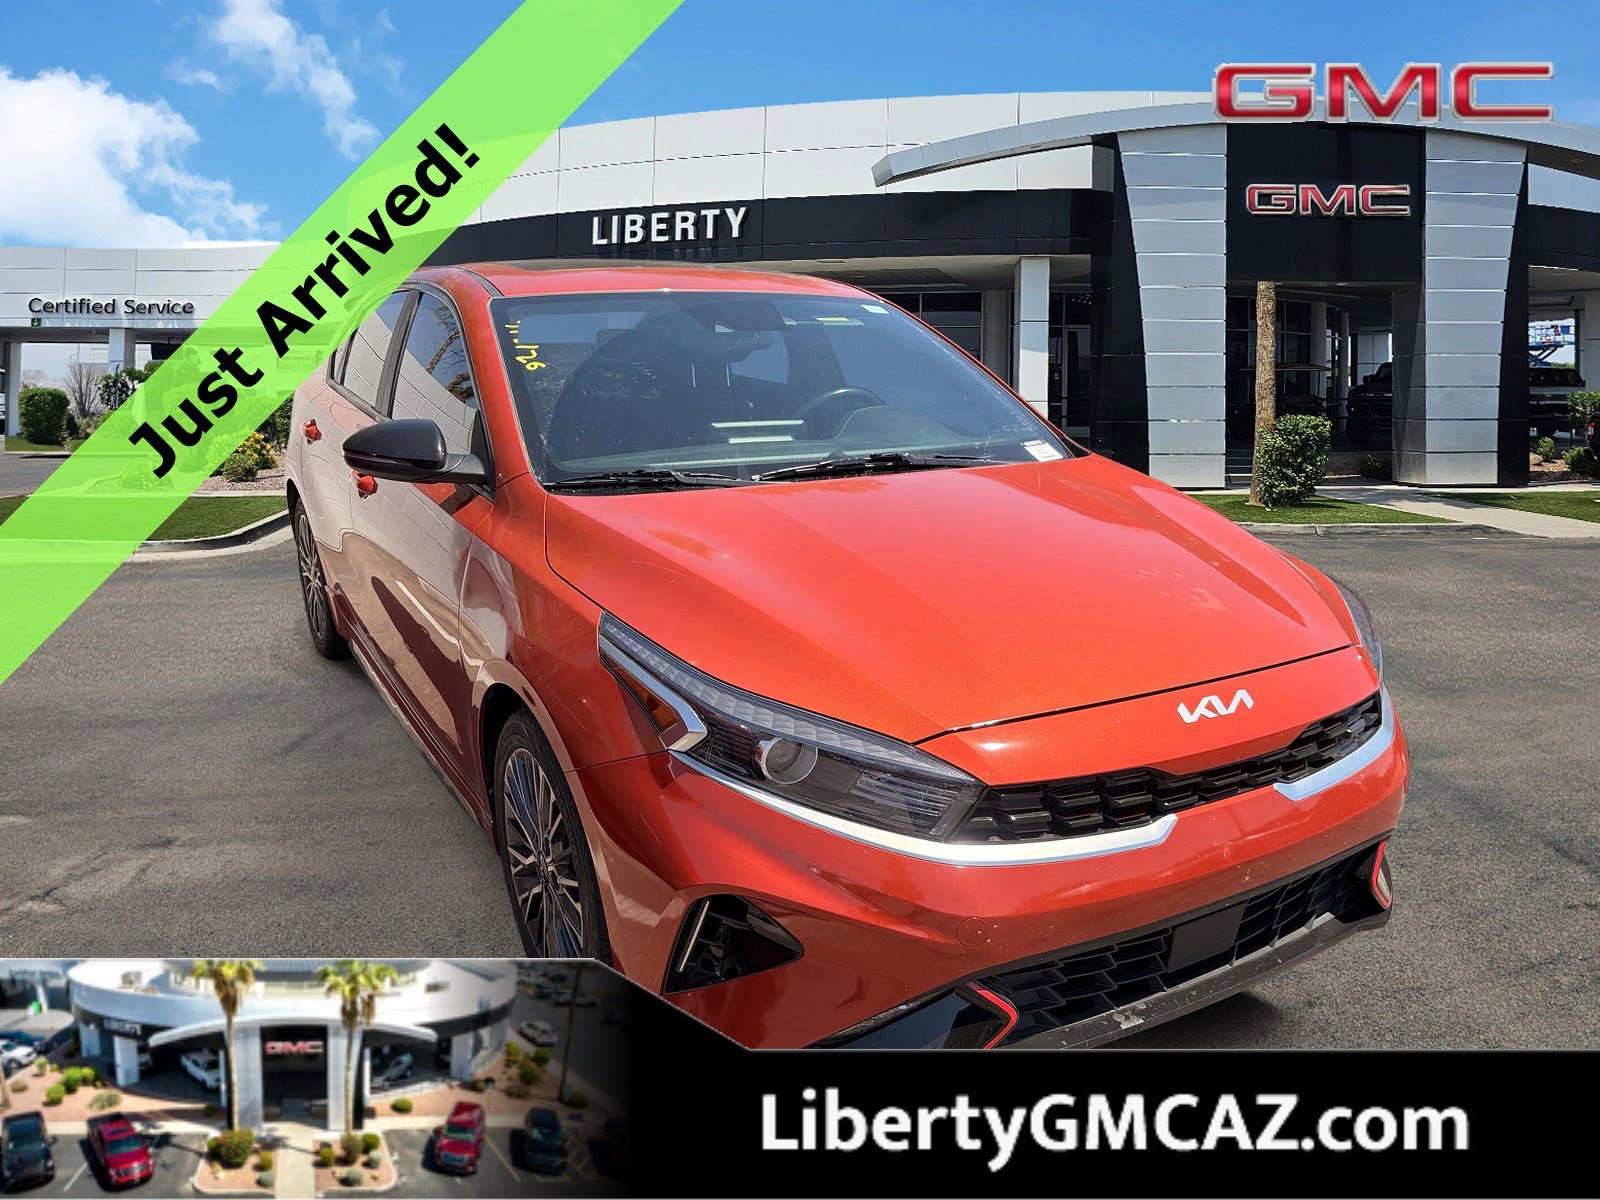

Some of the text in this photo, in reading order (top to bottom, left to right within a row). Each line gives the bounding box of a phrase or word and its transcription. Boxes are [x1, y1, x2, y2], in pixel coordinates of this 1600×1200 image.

[1246, 184, 1411, 217] GMC
[592, 206, 747, 246] LIBERTY
[28, 297, 195, 315] Certified Service
